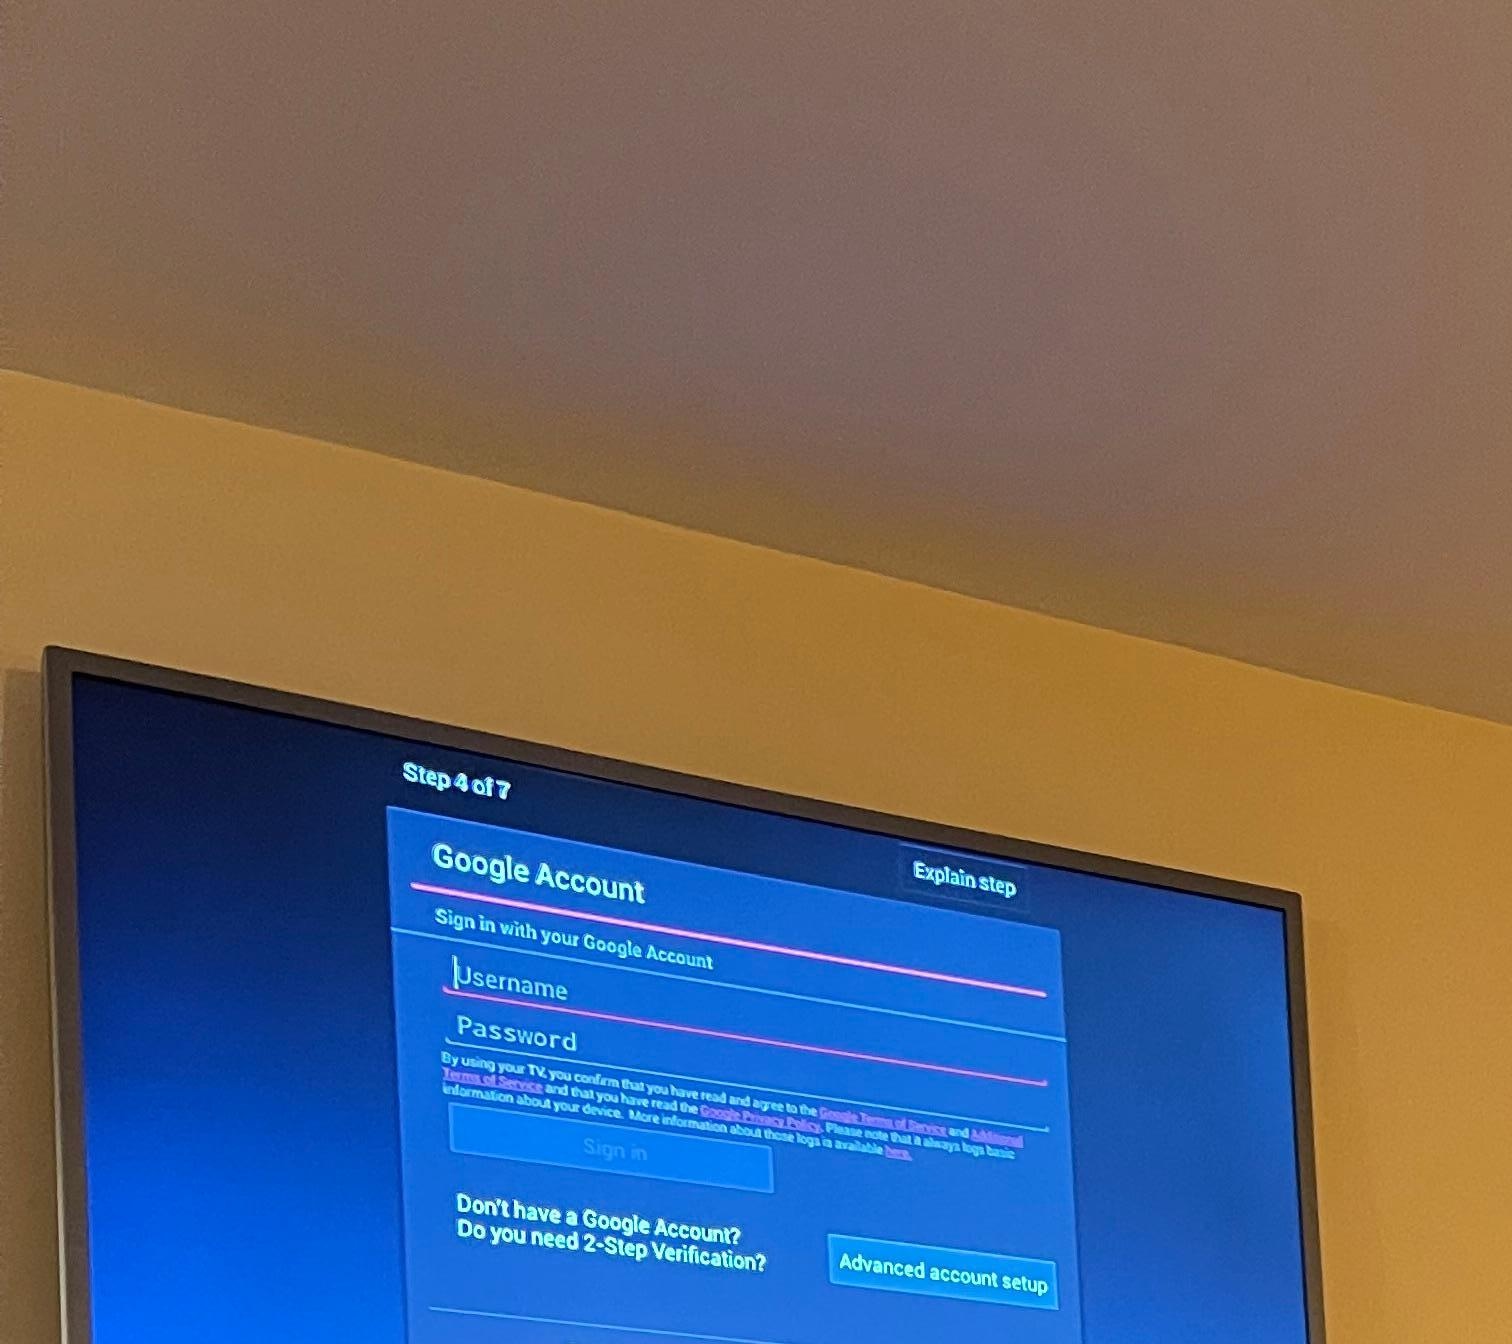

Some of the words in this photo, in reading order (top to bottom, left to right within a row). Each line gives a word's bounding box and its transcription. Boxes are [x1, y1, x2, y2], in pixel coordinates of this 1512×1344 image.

[403, 762, 451, 791] Step
[453, 772, 469, 792] 4
[472, 776, 494, 797] of
[496, 780, 511, 800] 7
[432, 843, 530, 884] Google
[535, 862, 646, 905] Account
[913, 860, 977, 889] Explain
[979, 876, 1018, 898] step
[435, 908, 475, 931] Sign
[479, 915, 496, 933] in
[500, 920, 537, 940] with
[541, 929, 579, 945] your
[583, 934, 642, 959] Google
[646, 945, 714, 970] Account
[456, 966, 569, 1001] Username
[457, 1015, 578, 1051] Password
[440, 1051, 459, 1066] By
[461, 1056, 495, 1072] using
[497, 1062, 525, 1075] your
[549, 1069, 572, 1081] you
[574, 1074, 620, 1088] confirm
[621, 1079, 645, 1091] that
[646, 1084, 669, 1095] you
[670, 1084, 698, 1100] have
[701, 1091, 727, 1104] read
[729, 1095, 751, 1107] and
[752, 1100, 784, 1112] agree
[786, 1103, 798, 1114] to
[799, 1104, 818, 1117] the
[948, 1127, 969, 1139] and
[442, 1067, 481, 1083] Terms
[483, 1072, 496, 1085] of
[498, 1075, 544, 1094] Service
[545, 1084, 568, 1096] and
[571, 1087, 594, 1100] that
[596, 1092, 619, 1103] you
[620, 1092, 649, 1107] have
[651, 1100, 678, 1112] read
[679, 1102, 698, 1114] the
[825, 1122, 863, 1138] Please
[864, 1129, 889, 1142] note
[890, 1131, 913, 1145] that
[962, 1142, 985, 1157] logs
[442, 1082, 514, 1103] information
[516, 1094, 551, 1109] about
[553, 1101, 580, 1113] your
[628, 1109, 660, 1124] More
[662, 1114, 728, 1133] information
[729, 1124, 762, 1138] about
[797, 1132, 821, 1148] logs
[834, 1138, 884, 1156] available
[583, 1137, 626, 1161] Sign
[630, 1144, 648, 1161] in
[456, 1193, 510, 1218] Don't
[513, 1199, 561, 1224] have
[565, 1210, 578, 1226] a
[582, 1209, 650, 1237] Google
[654, 1218, 742, 1245] Account?
[456, 1218, 486, 1240] Do
[490, 1226, 527, 1245] you
[531, 1230, 579, 1251] need
[583, 1235, 649, 1262] 2-Step
[652, 1241, 767, 1273] Verification?
[839, 1252, 926, 1279] Advanced
[929, 1267, 999, 1288] account
[1002, 1275, 1049, 1297] setup
